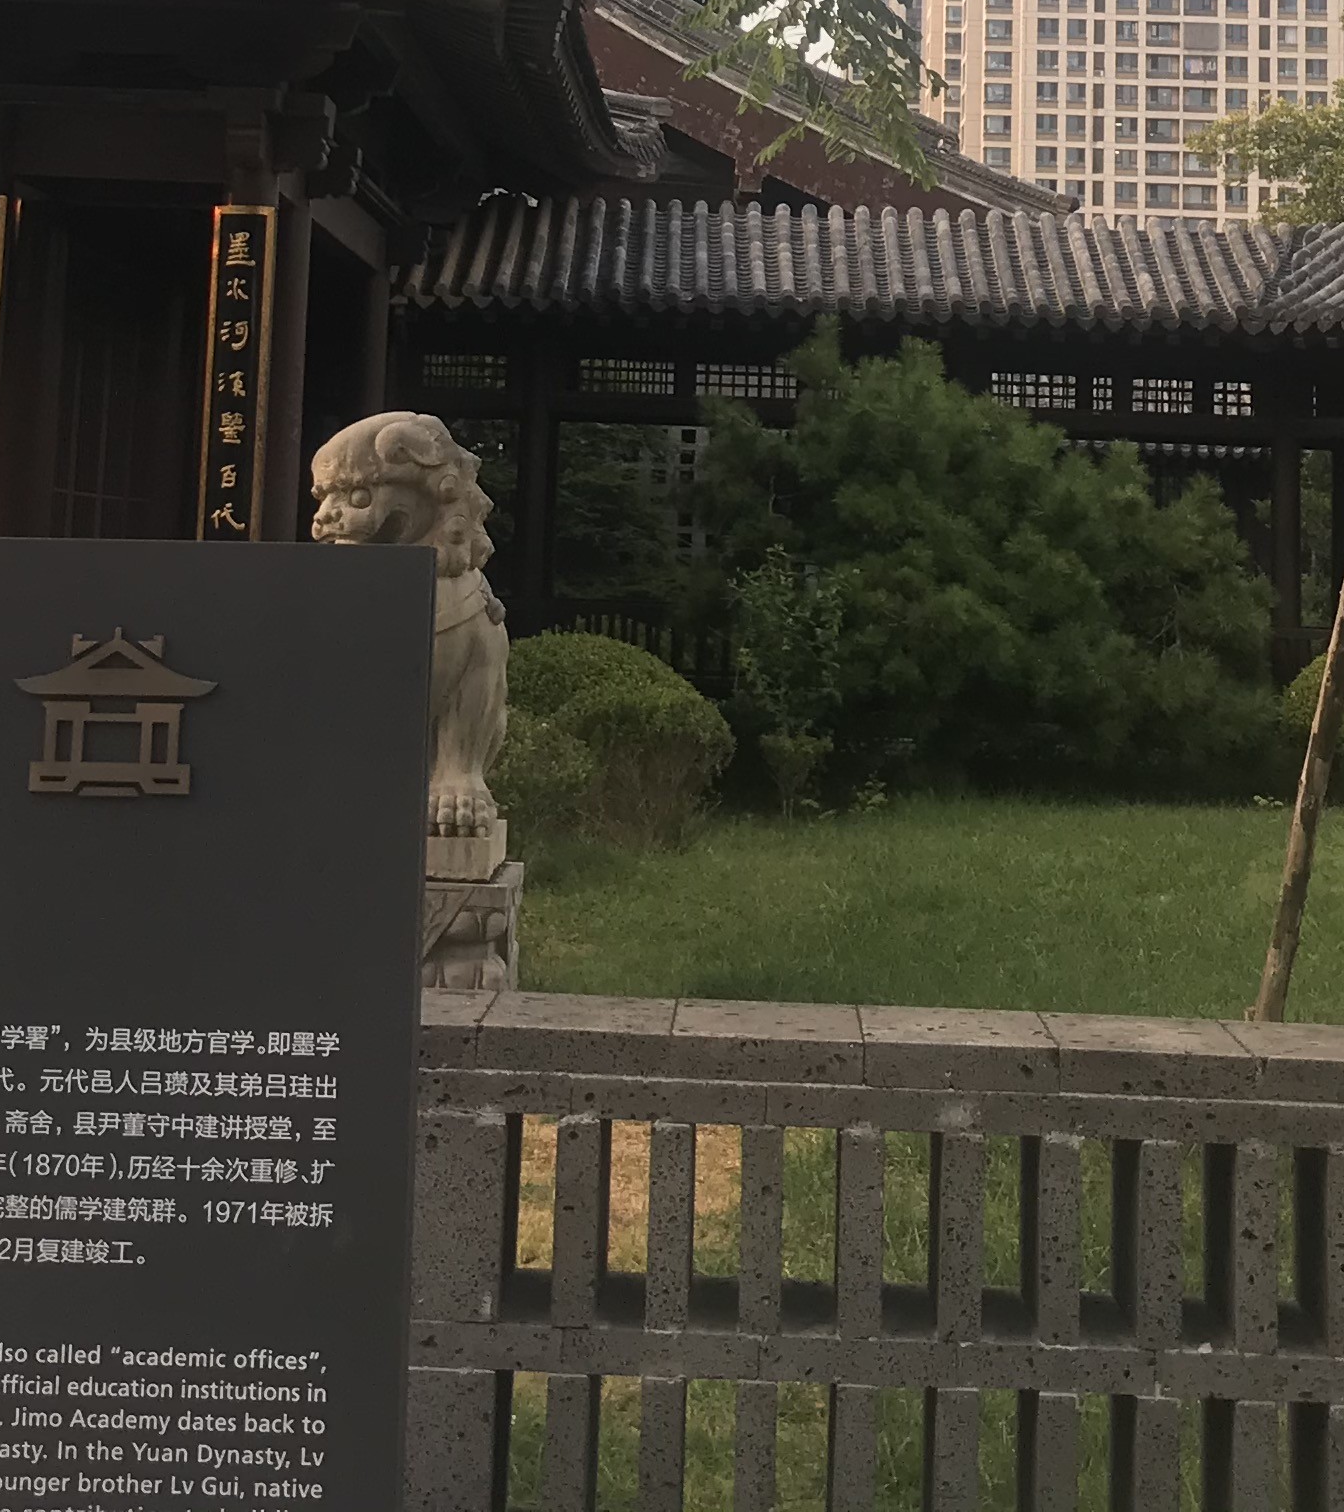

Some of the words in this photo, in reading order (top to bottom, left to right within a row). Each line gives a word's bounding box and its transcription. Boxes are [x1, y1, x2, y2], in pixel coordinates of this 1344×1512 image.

[35, 1343, 101, 1365] called
[67, 1376, 173, 1399] education
[180, 1379, 300, 1401] institutions
[307, 1383, 327, 1402] in
[11, 1406, 62, 1427] Jimo
[69, 1408, 171, 1435] Academy
[178, 1411, 237, 1432] dates
[244, 1412, 295, 1434] back
[302, 1416, 326, 1434] to
[57, 1440, 78, 1460] In
[85, 1440, 124, 1461] the
[132, 1442, 188, 1463] Yuan
[197, 1444, 291, 1470] Dynasty,
[300, 1447, 325, 1466] Lv
[78, 1472, 163, 1494] brother
[170, 1475, 194, 1496] Lv
[201, 1476, 245, 1500] Gui,
[254, 1478, 323, 1499] native
